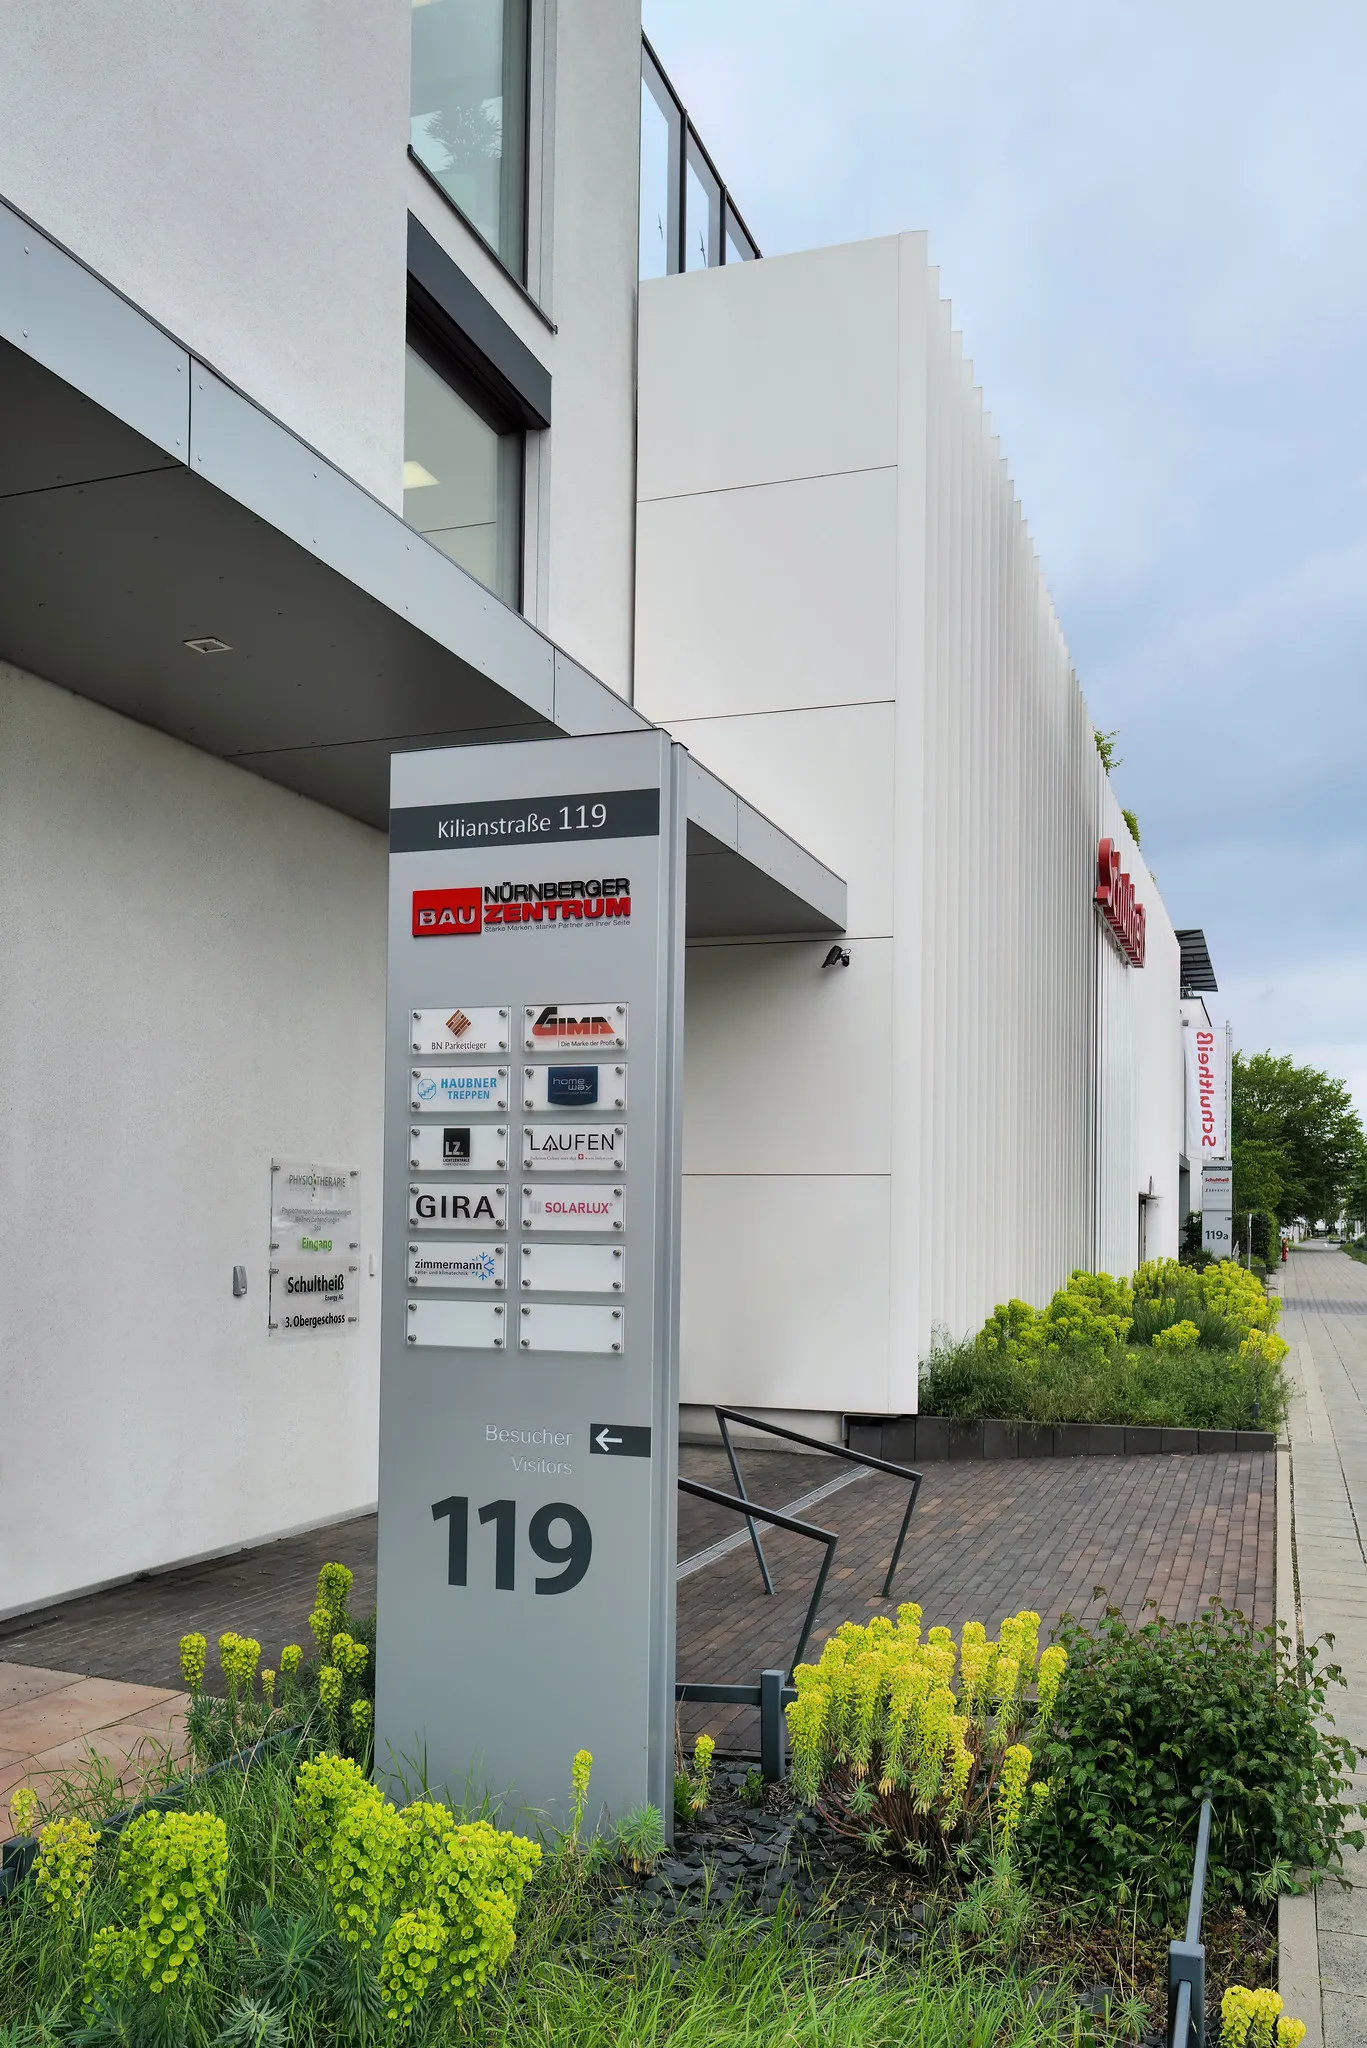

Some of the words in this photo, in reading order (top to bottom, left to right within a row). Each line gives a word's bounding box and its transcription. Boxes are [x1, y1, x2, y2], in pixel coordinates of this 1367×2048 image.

[438, 813, 551, 838] Kilianstraße
[558, 804, 607, 830] 119
[484, 878, 630, 902] NÜRNBERGER
[418, 905, 476, 927] BAU
[484, 897, 631, 924] ZENTRUM
[532, 1007, 615, 1036] GIMA
[431, 1042, 443, 1050] BN
[444, 1042, 487, 1051] Parkettleger
[441, 1078, 497, 1089] HAUBNER
[448, 1090, 490, 1100] TREPPEN
[530, 1134, 614, 1151] LAUFEN
[416, 1194, 495, 1219] GIRA
[302, 1237, 333, 1251] Eingang
[1205, 1230, 1228, 1240] 119a
[415, 1259, 482, 1270] zimmermann
[288, 1274, 344, 1293] Schultheiß
[285, 1316, 292, 1328] 3.
[293, 1313, 345, 1328] Obergeschoss
[486, 1424, 573, 1446] Besucher
[511, 1456, 573, 1475] Visitors
[431, 1496, 593, 1595] 119
